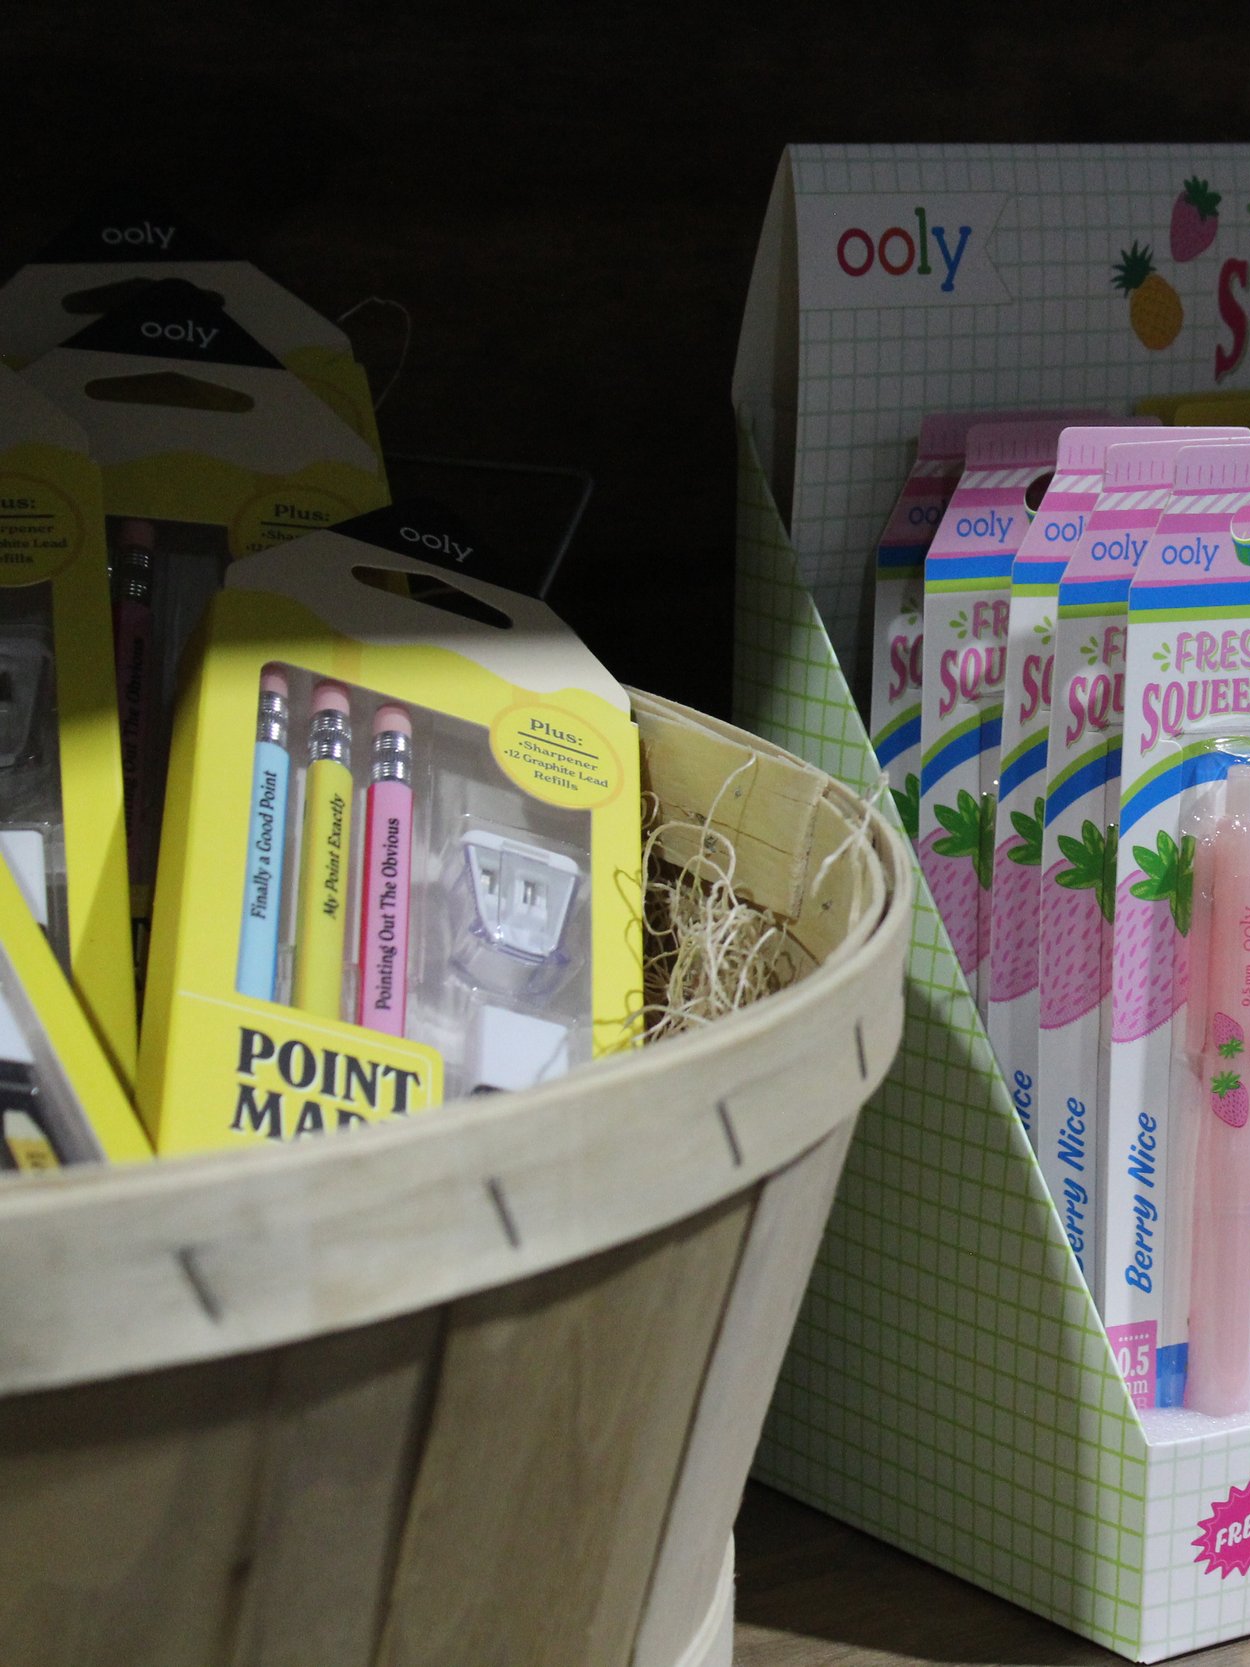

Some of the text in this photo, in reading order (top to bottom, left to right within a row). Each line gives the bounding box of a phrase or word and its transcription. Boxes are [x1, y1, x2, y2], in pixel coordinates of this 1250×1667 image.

[101, 222, 176, 250] ooly
[837, 207, 971, 291] ooly
[140, 320, 219, 348] ooly
[957, 511, 1014, 543] ooly
[1045, 515, 1084, 542] ool
[400, 526, 475, 564] ooly
[1091, 533, 1149, 567] ooly
[1162, 537, 1219, 572] ooly
[530, 717, 583, 747] Plus:
[508, 748, 609, 788] 12 Graphite Lead
[523, 740, 599, 772] Sharpener
[533, 769, 579, 791] Refills
[250, 770, 277, 919] Finally a Good Point
[323, 792, 346, 920] My Point Exactly
[375, 817, 400, 1011] Pointing Out The Obvious
[1240, 985, 1250, 1007] 0.5
[237, 1027, 421, 1114] POINT
[1057, 1097, 1089, 1273] erry Nice
[1125, 1111, 1158, 1294] Berry Nice
[1118, 1344, 1150, 1379] 0.5
